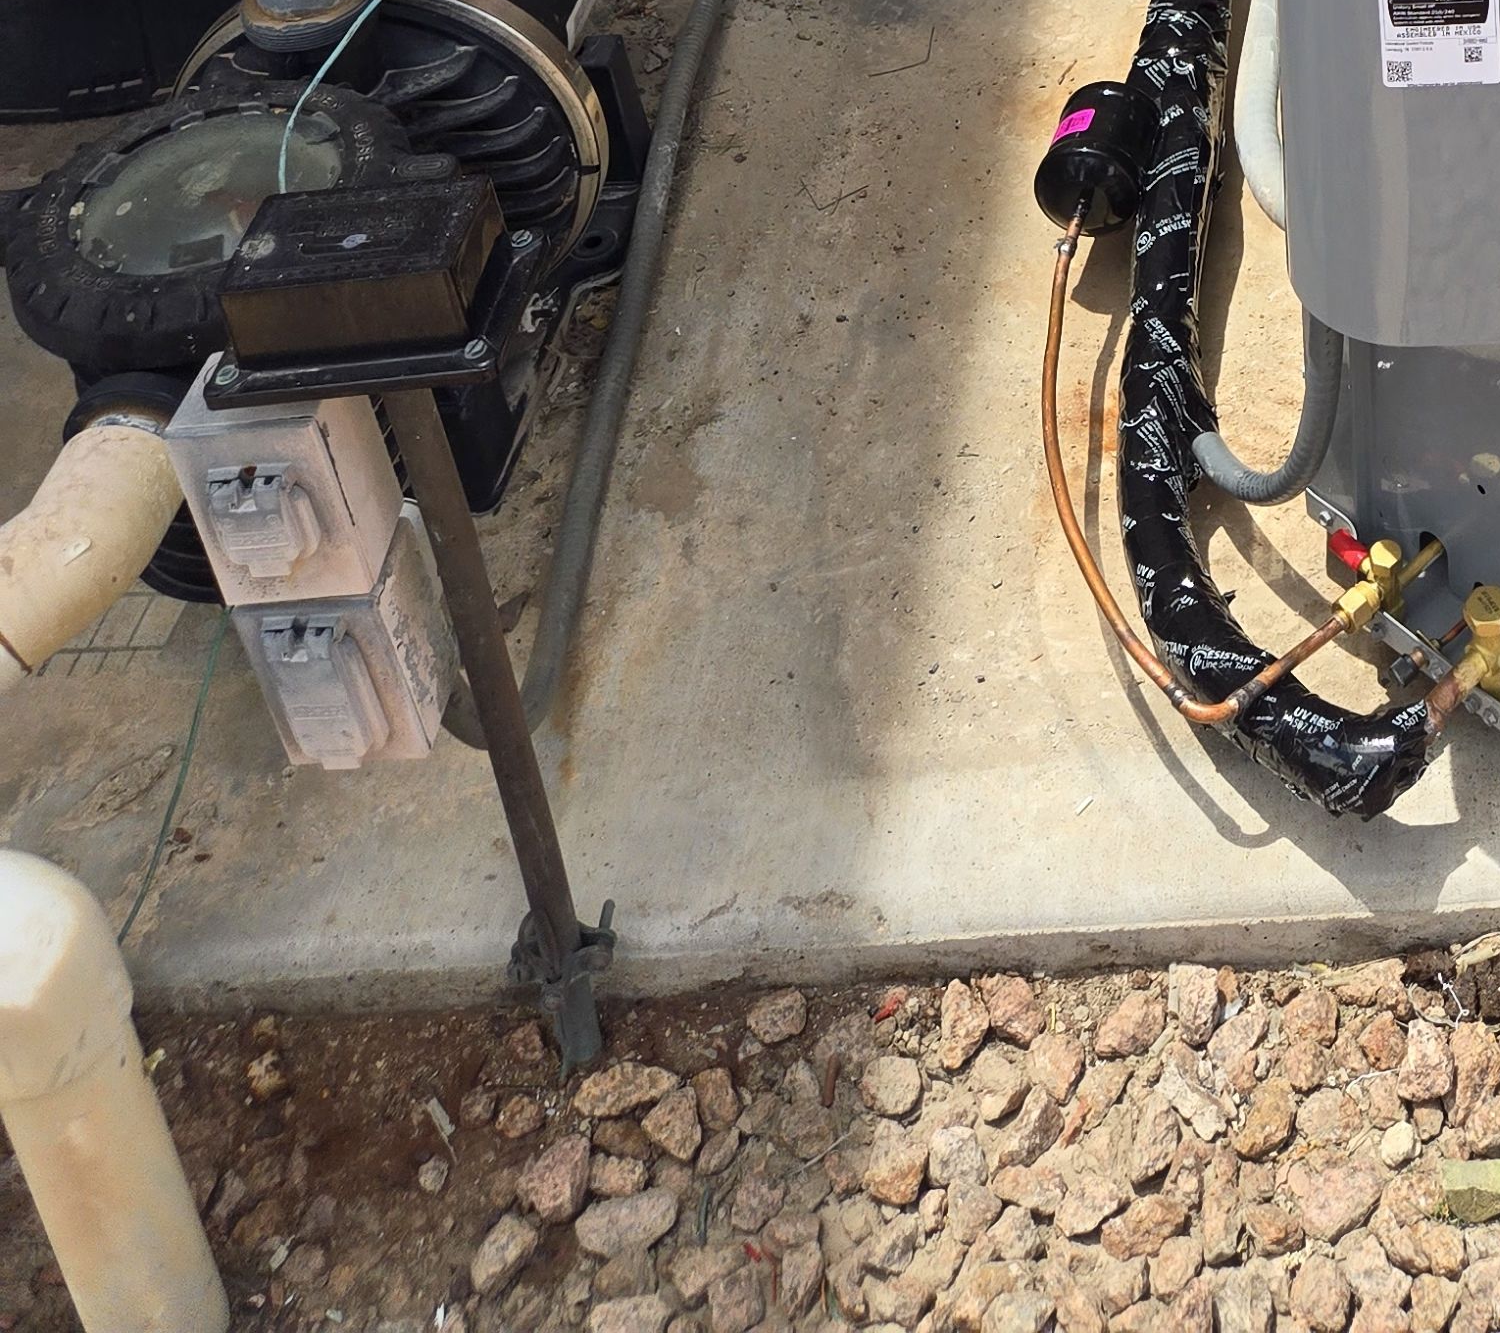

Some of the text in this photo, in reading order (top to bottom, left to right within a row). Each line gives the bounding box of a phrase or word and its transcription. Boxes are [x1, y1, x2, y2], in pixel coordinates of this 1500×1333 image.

[1219, 661, 1232, 669] Set
[1235, 661, 1255, 672] Tape
[1293, 706, 1311, 721] UV
[1392, 712, 1409, 726] UV
